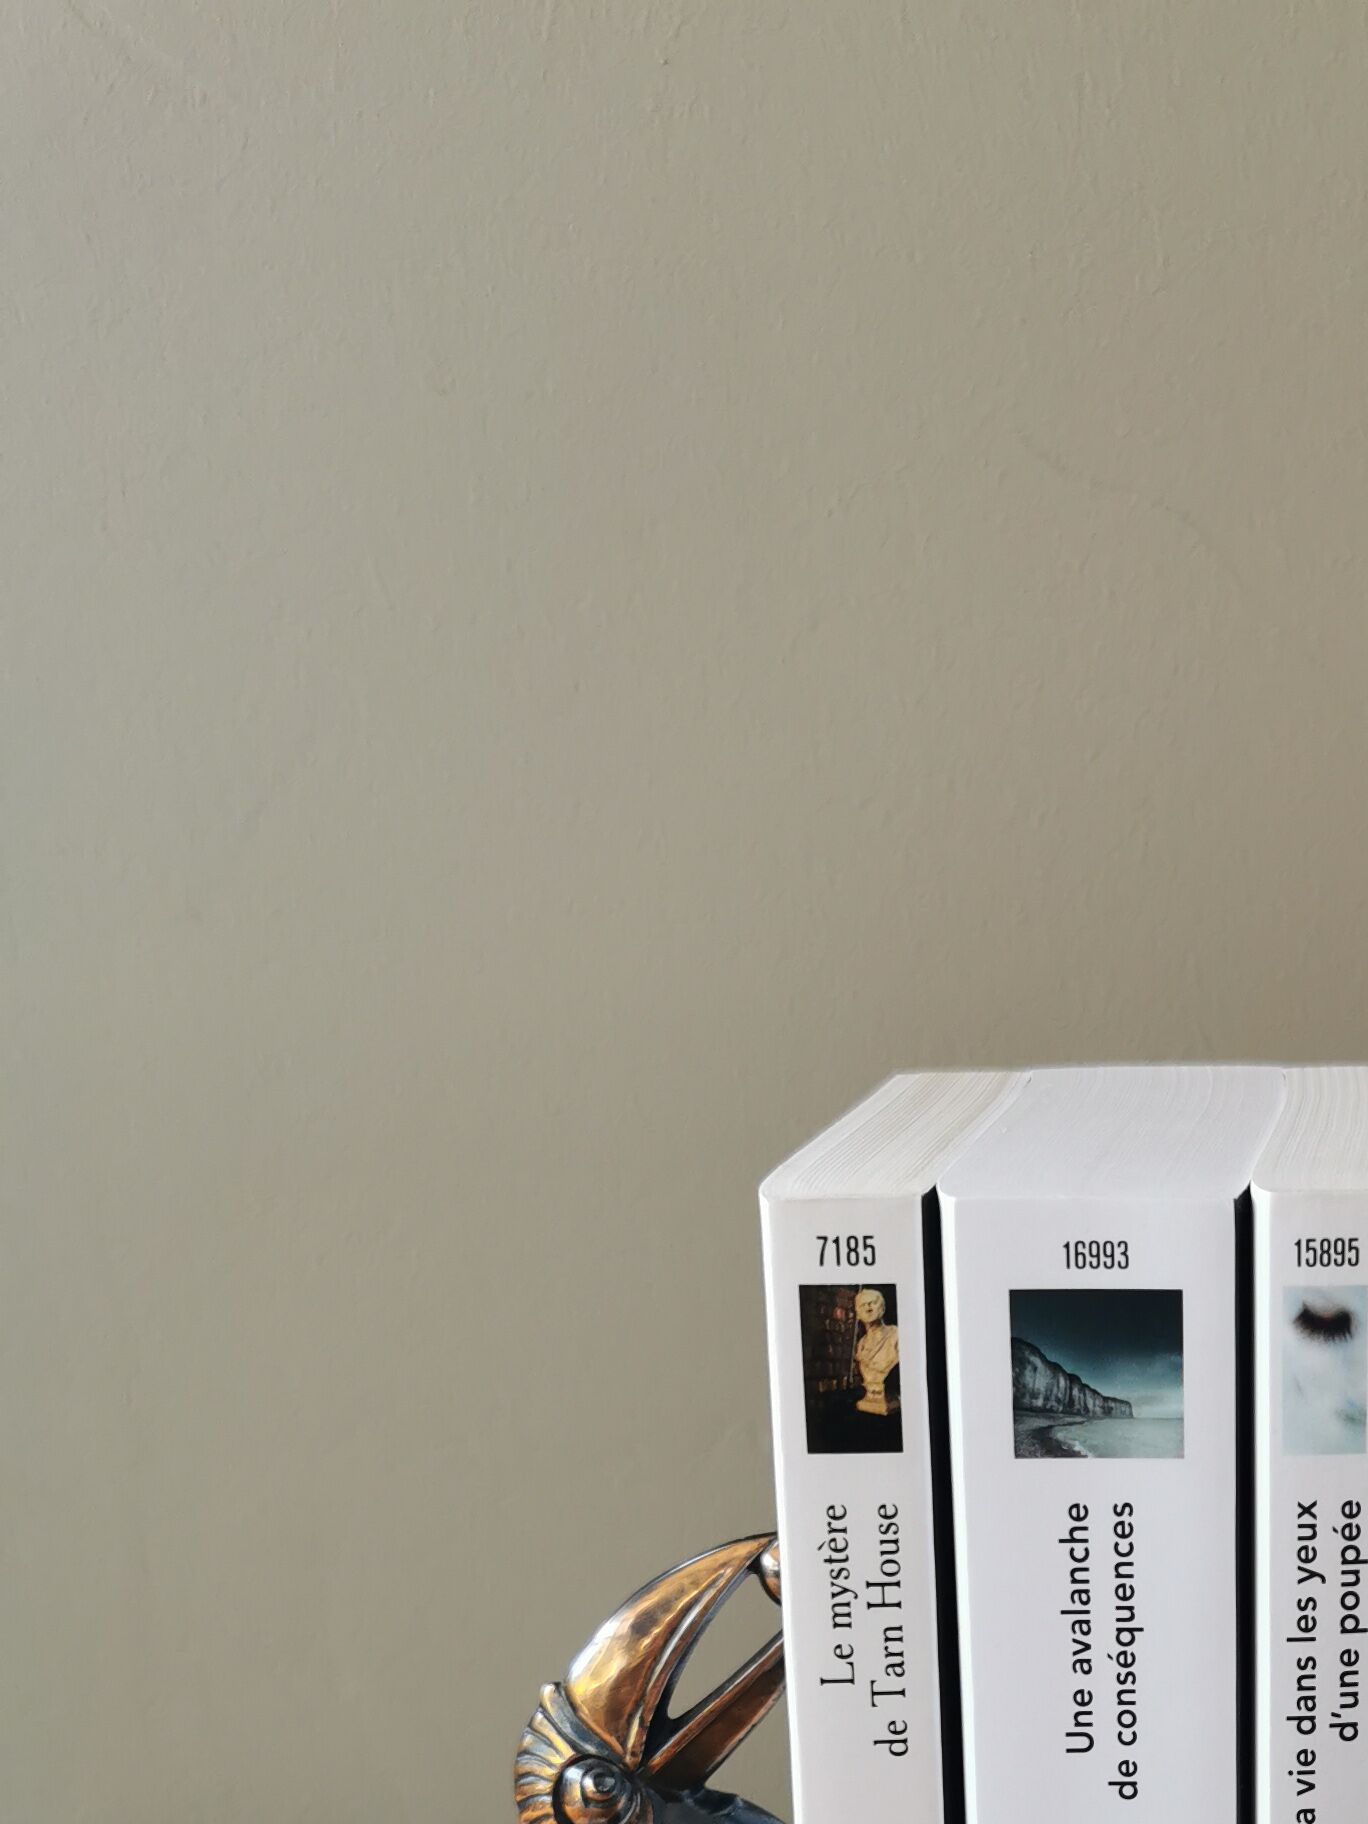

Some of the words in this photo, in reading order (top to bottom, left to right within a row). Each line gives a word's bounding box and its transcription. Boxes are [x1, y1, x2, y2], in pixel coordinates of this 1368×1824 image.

[816, 1235, 876, 1267] 7185
[1063, 1240, 1129, 1269] 16993
[1294, 1238, 1359, 1267] 15895
[817, 1505, 858, 1630] mystère
[865, 1504, 903, 1610] House
[1297, 1500, 1326, 1585] yeux
[1332, 1500, 1368, 1635] poupée
[1058, 1503, 1093, 1676] avalanche
[1286, 1597, 1317, 1643] les
[1107, 1502, 1145, 1747] conséquences
[820, 1644, 856, 1686] Le
[870, 1624, 907, 1707] Tarn
[1286, 1655, 1317, 1736] dans
[873, 1720, 908, 1757] de
[1065, 1689, 1094, 1753] Une
[1108, 1760, 1138, 1800] de
[1287, 1748, 1317, 1797] vie
